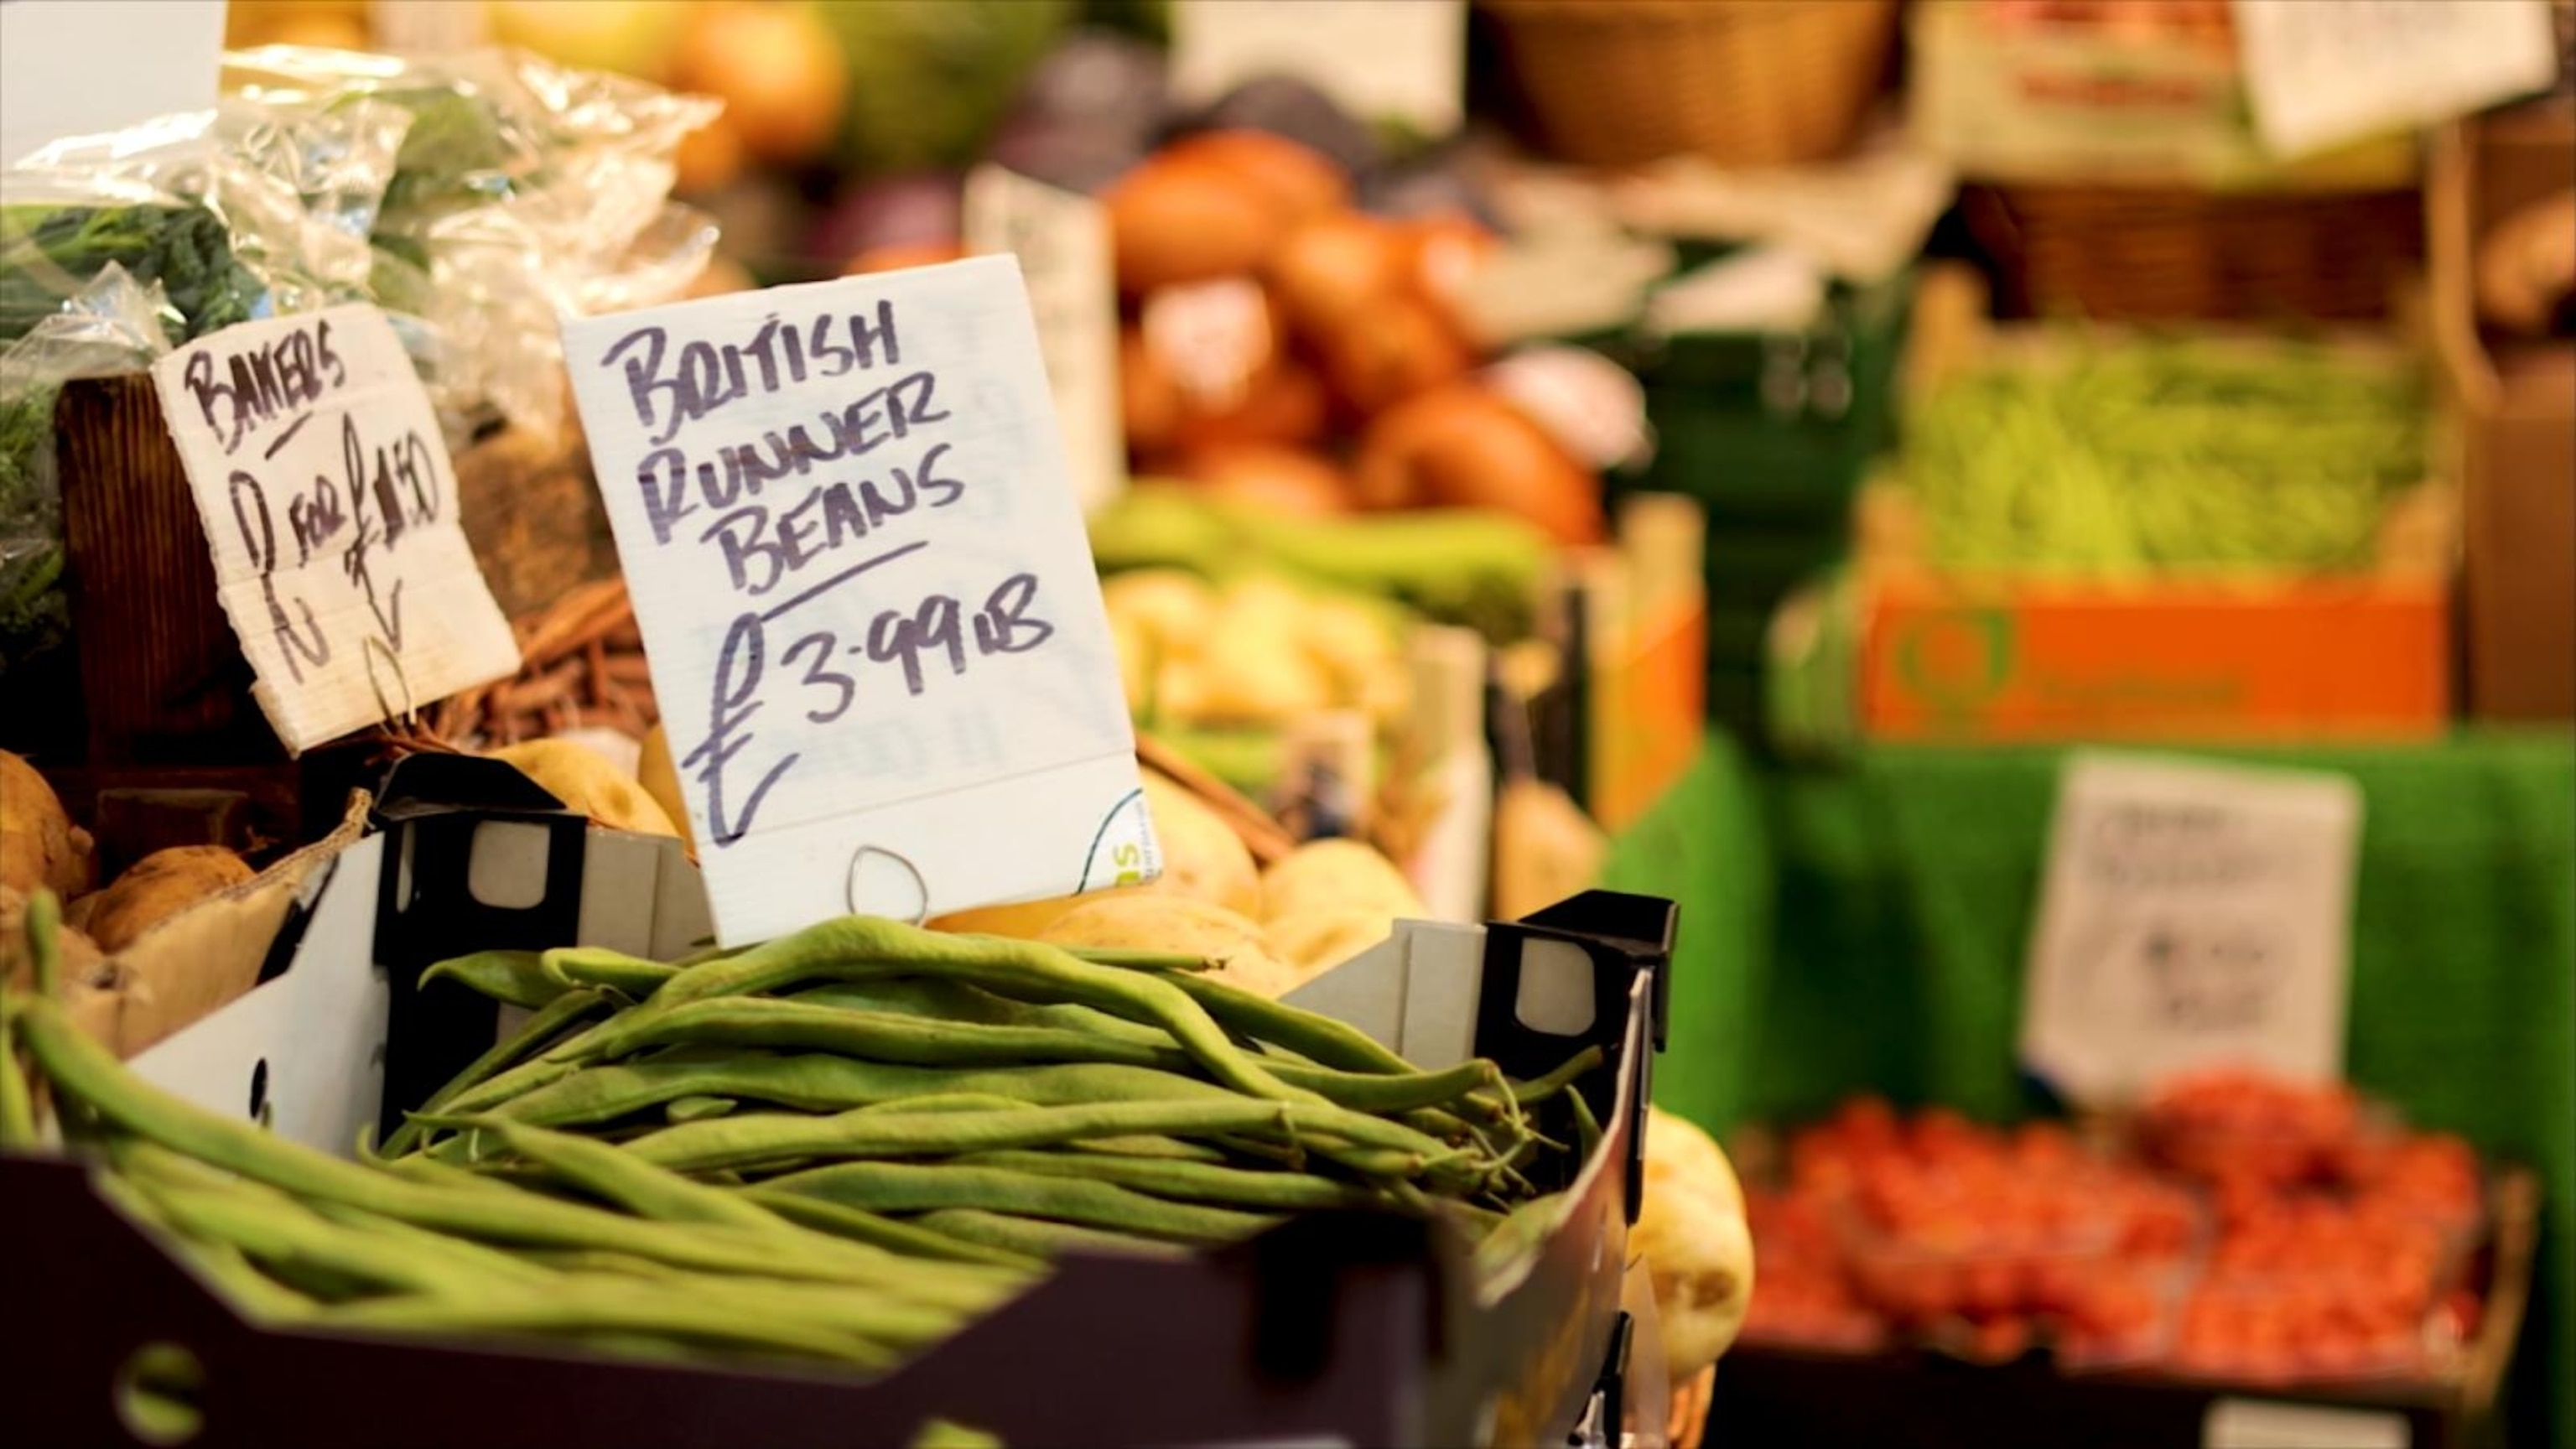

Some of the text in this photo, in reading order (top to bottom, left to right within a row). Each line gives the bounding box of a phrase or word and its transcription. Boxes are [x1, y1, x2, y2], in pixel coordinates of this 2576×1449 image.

[184, 318, 345, 456] BAKERS
[601, 299, 901, 445] BRITISH
[288, 474, 346, 569] FOR
[637, 371, 951, 545] RUNNER
[699, 443, 964, 595] BEANS
